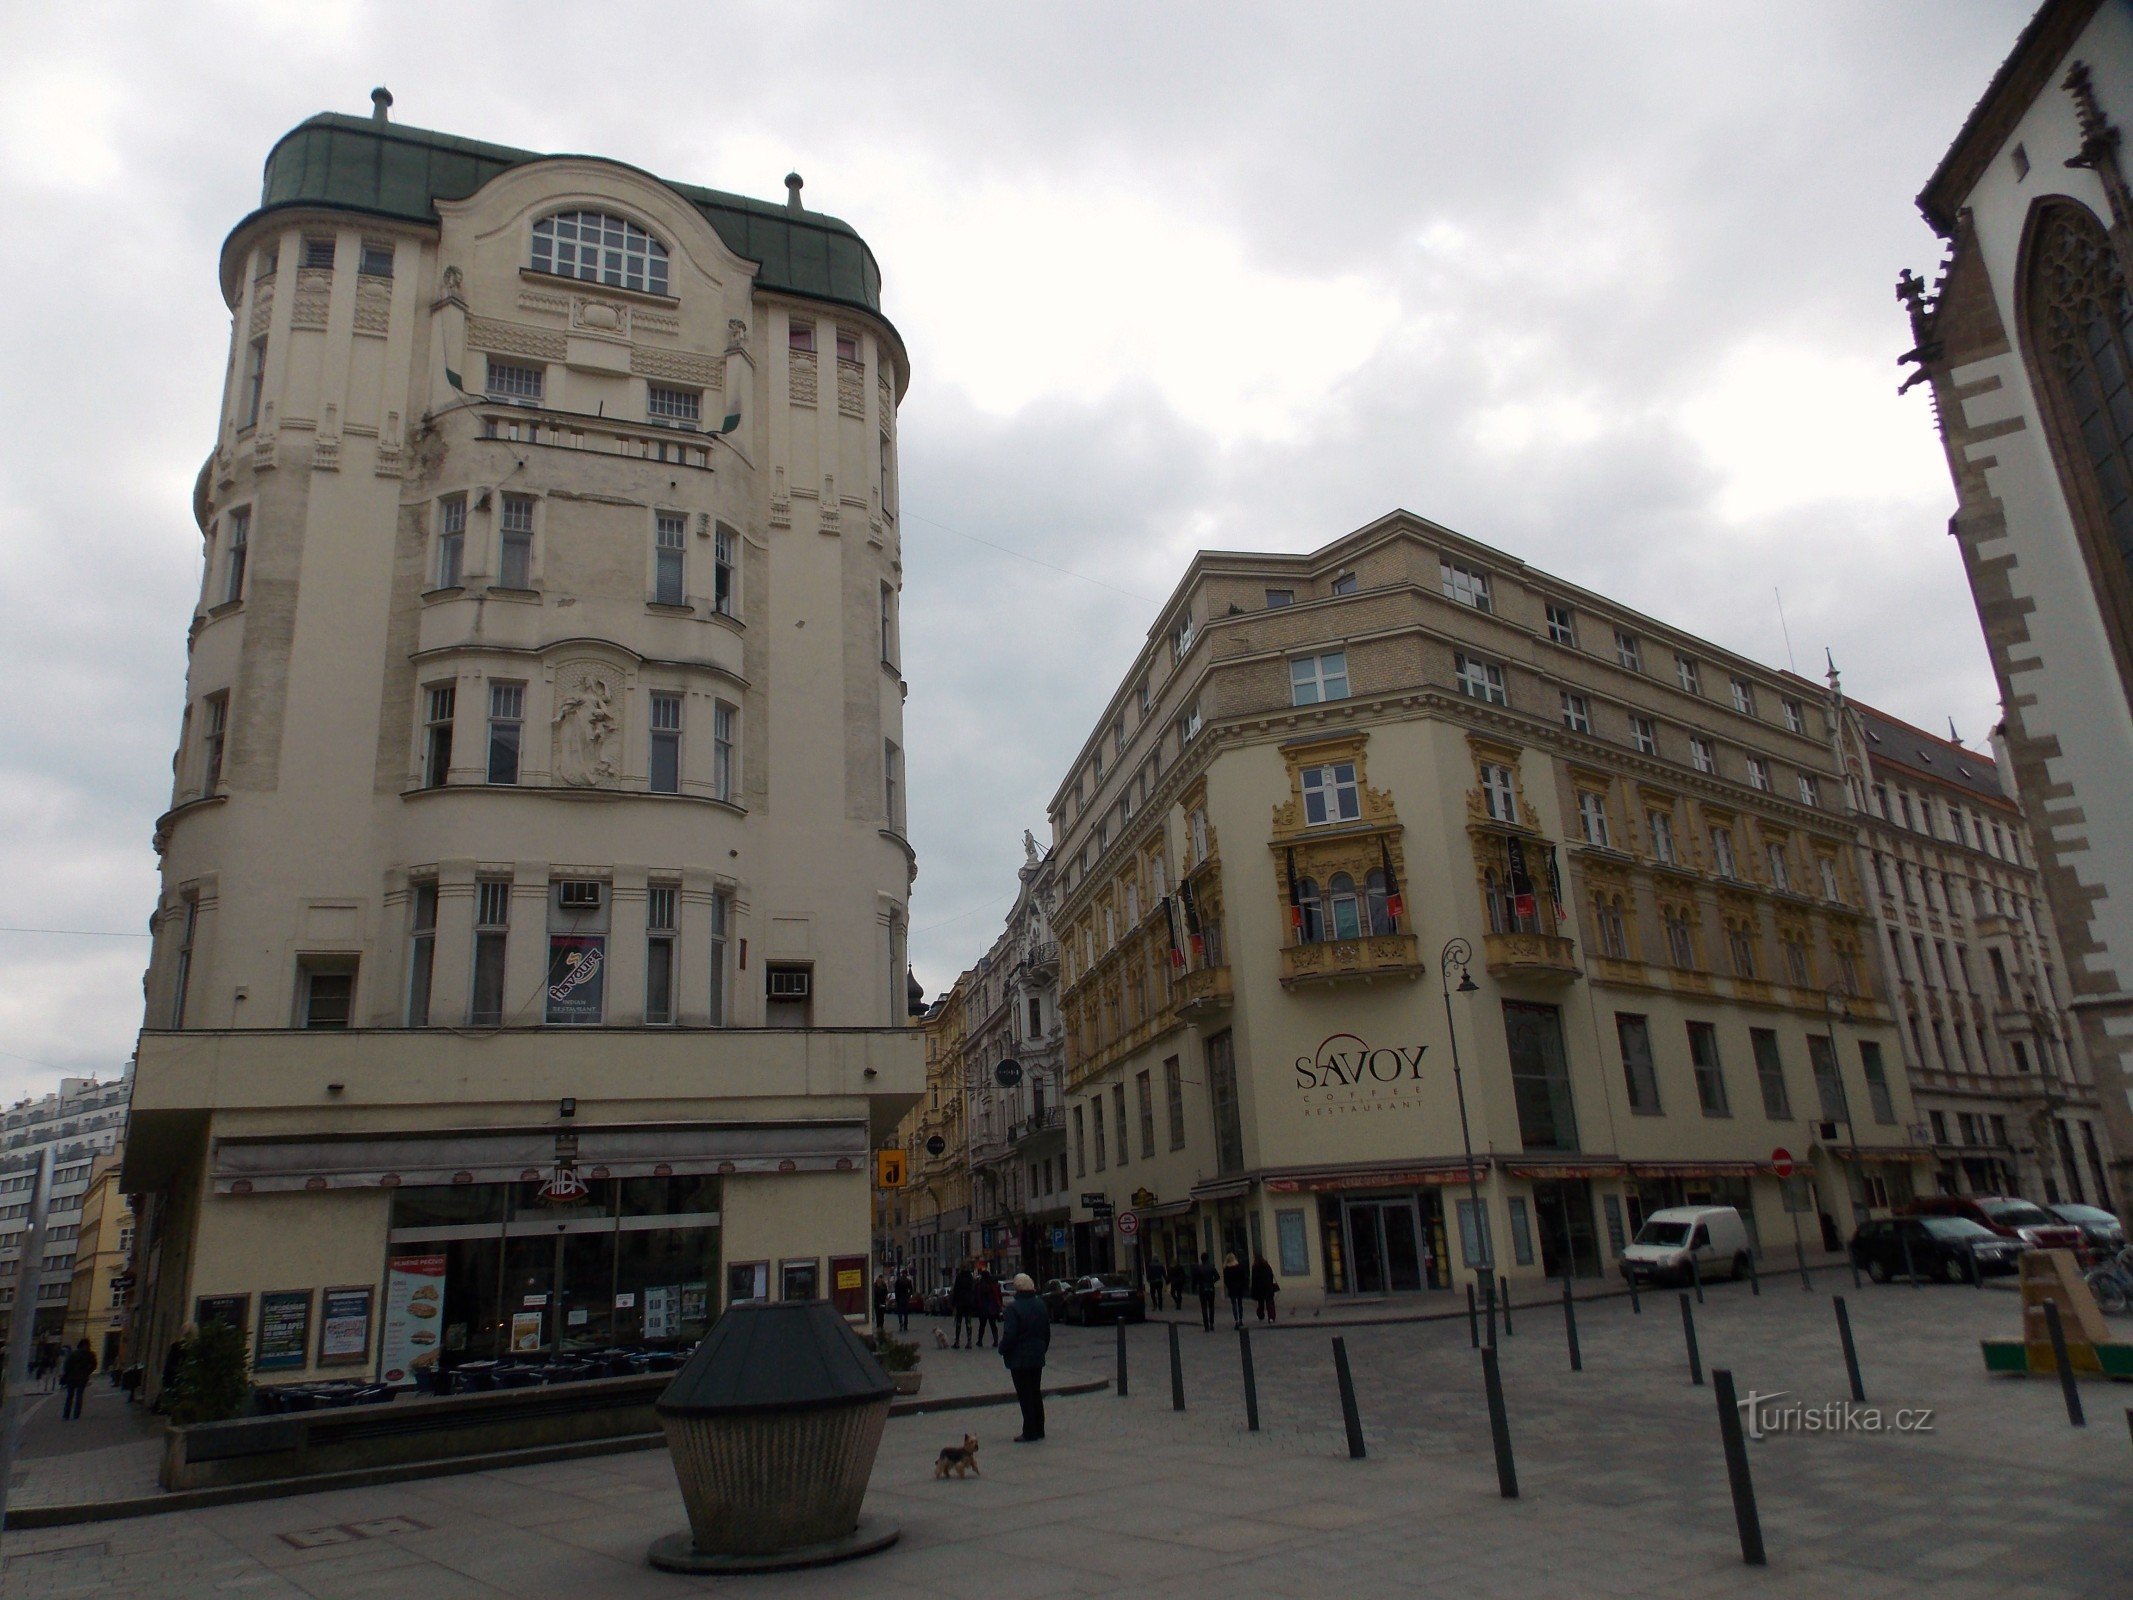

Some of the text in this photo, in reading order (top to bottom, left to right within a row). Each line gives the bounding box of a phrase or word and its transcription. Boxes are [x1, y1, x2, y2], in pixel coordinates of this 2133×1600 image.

[1295, 1045, 1429, 1090] SAVOY
[1303, 1085, 1422, 1103] COFFEE
[1304, 1101, 1423, 1117] RESTAURANT
[536, 1168, 590, 1196] AIDA
